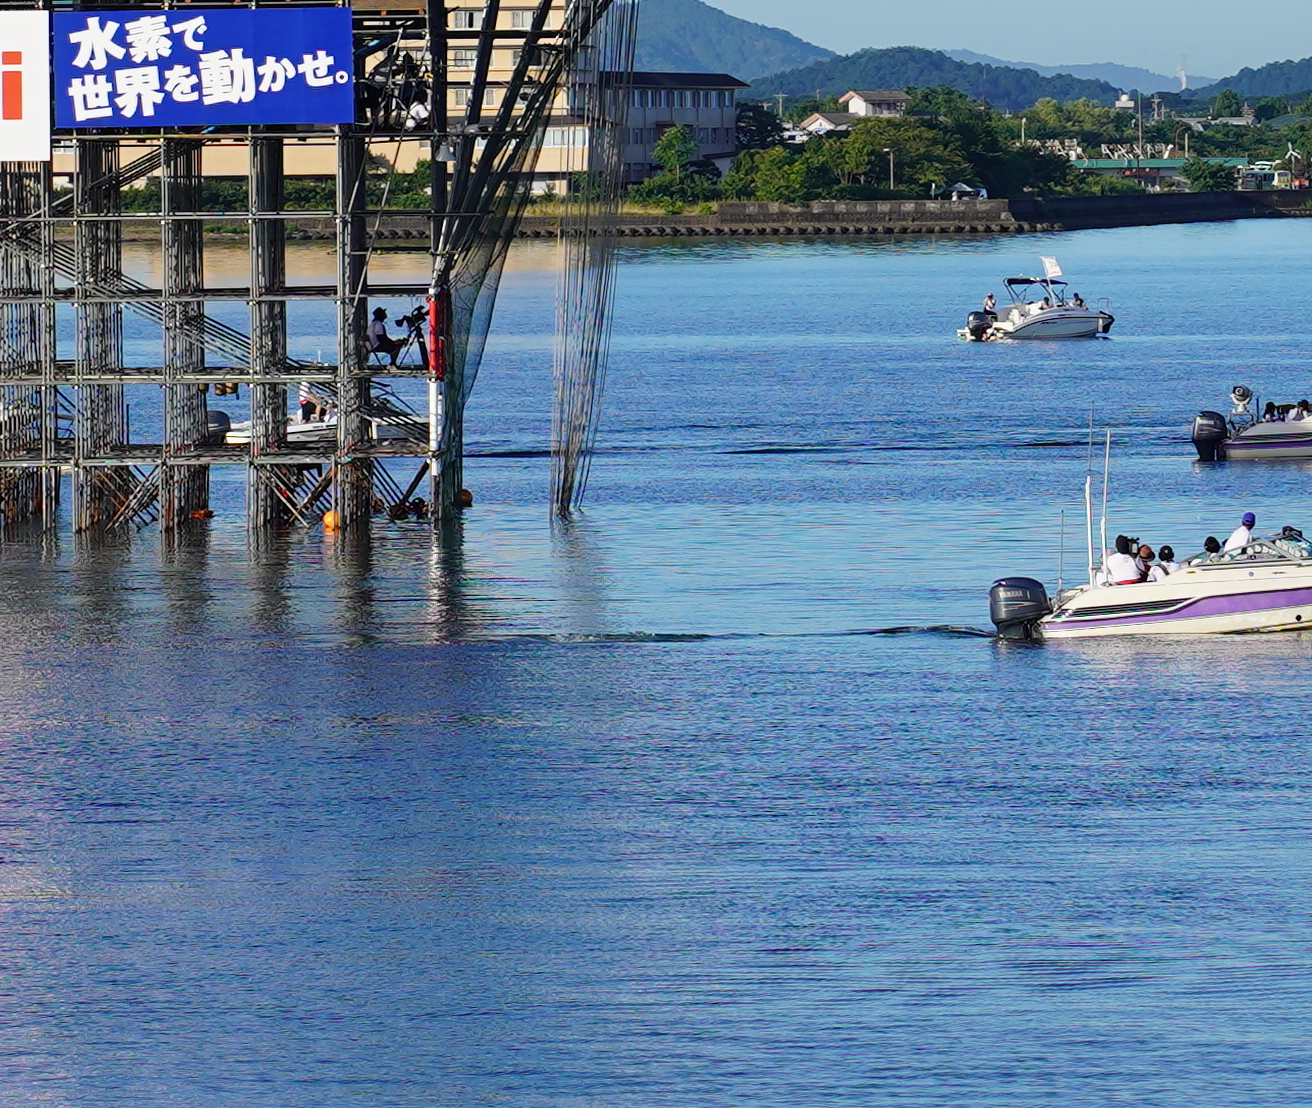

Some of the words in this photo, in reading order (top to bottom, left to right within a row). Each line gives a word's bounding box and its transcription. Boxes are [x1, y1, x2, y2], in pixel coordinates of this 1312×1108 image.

[68, 15, 208, 71] 水素で
[67, 48, 349, 122] 世界を動かせ。
